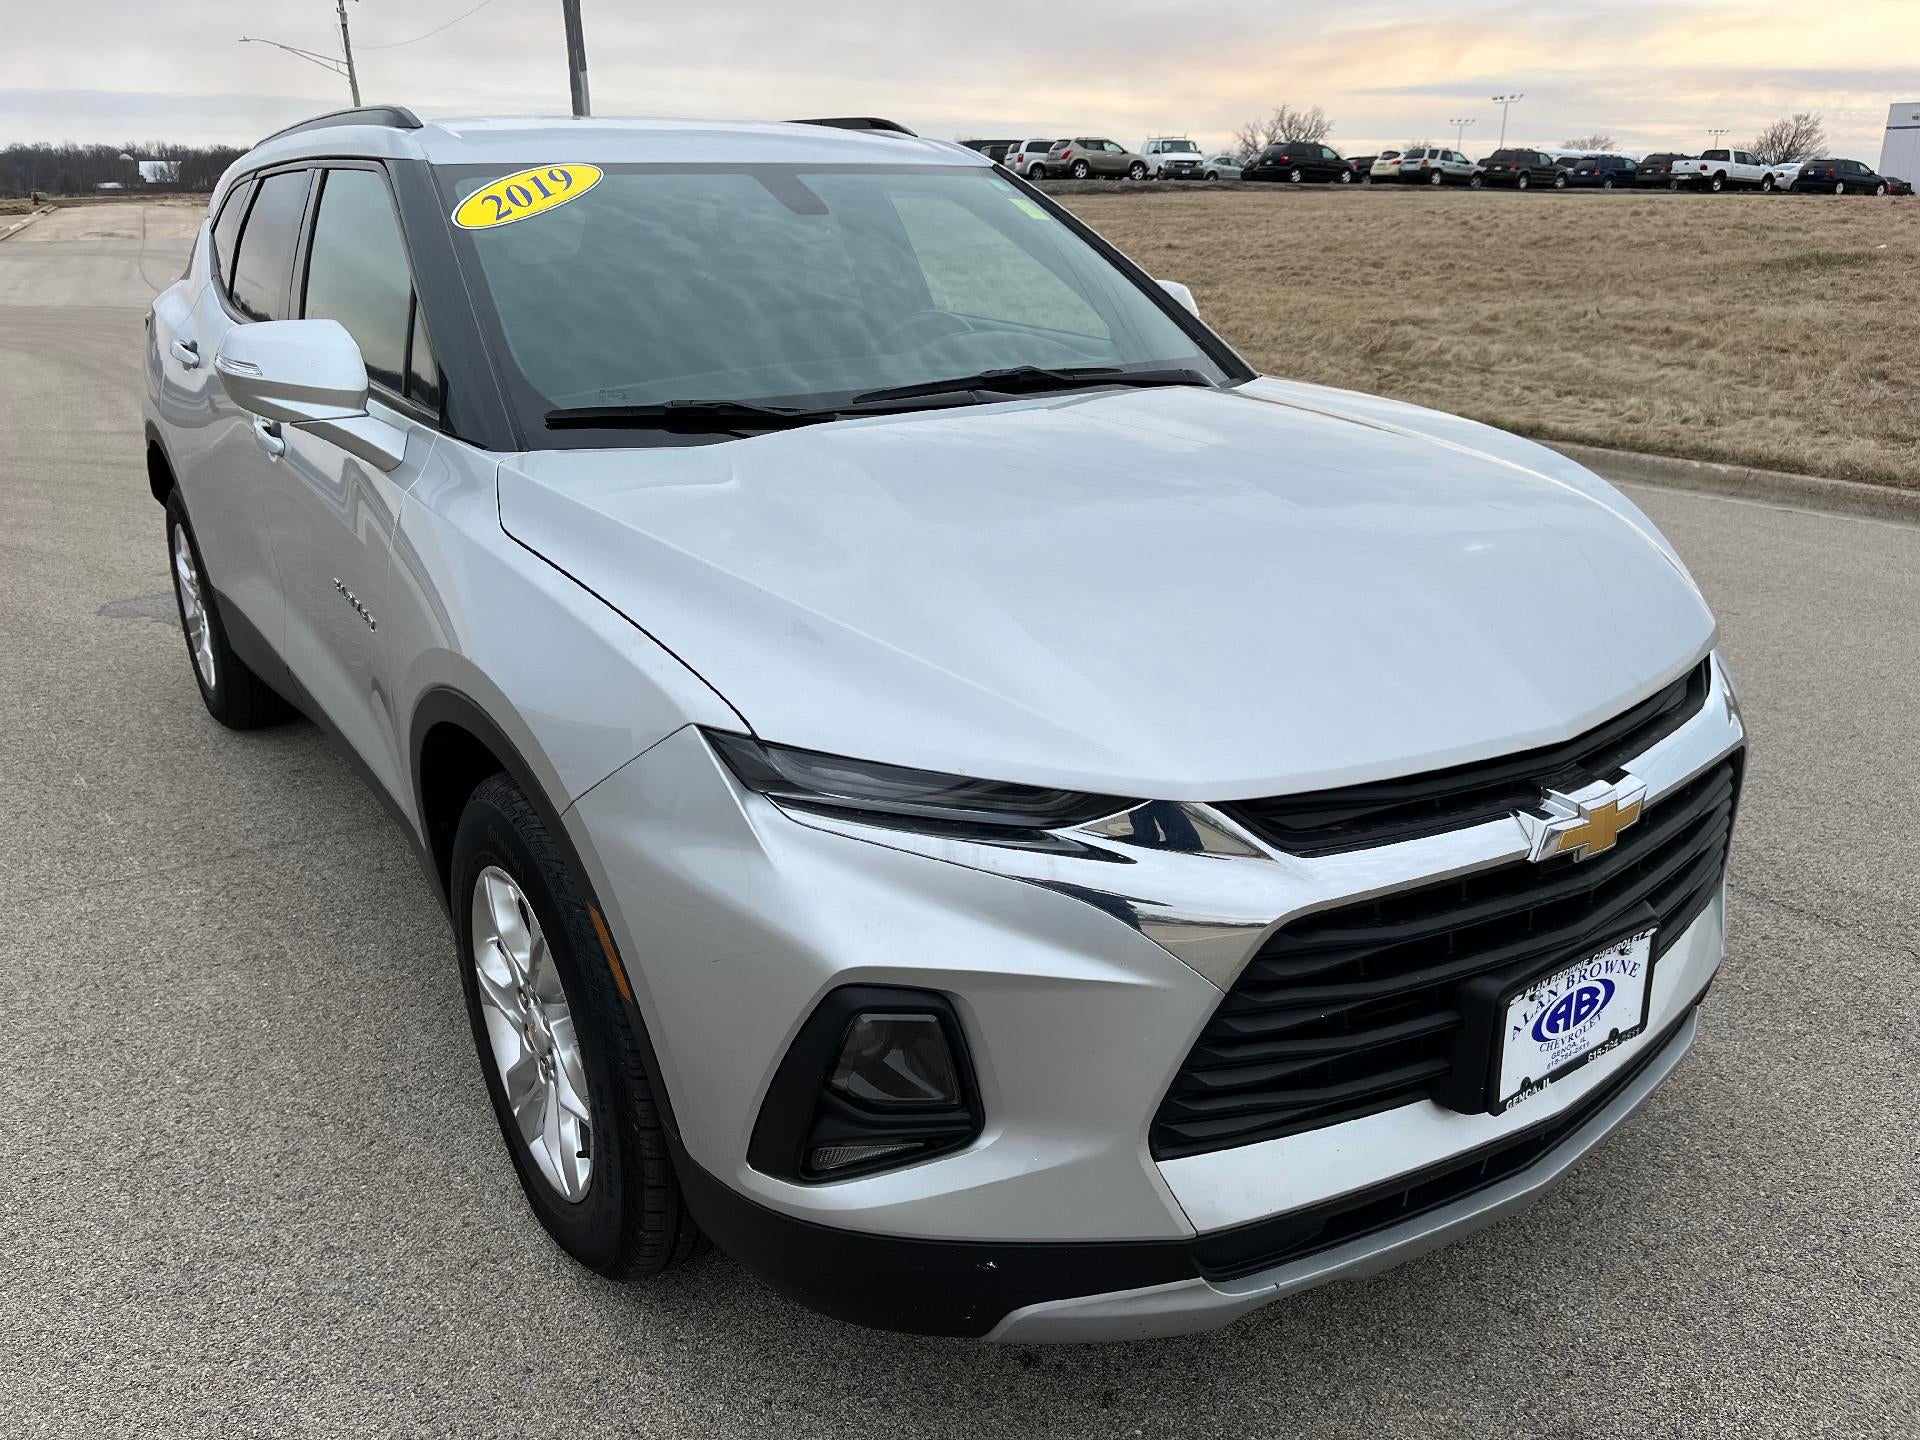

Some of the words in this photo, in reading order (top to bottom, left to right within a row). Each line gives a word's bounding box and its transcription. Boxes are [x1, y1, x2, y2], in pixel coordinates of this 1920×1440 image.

[481, 168, 573, 221] 2019
[1550, 957, 1590, 983] BROWNE
[1592, 932, 1644, 963] CHEVROLET
[1512, 982, 1559, 1041] ALAN
[1566, 958, 1641, 990] BROWNE
[1539, 1013, 1602, 1053] CHEVROLET
